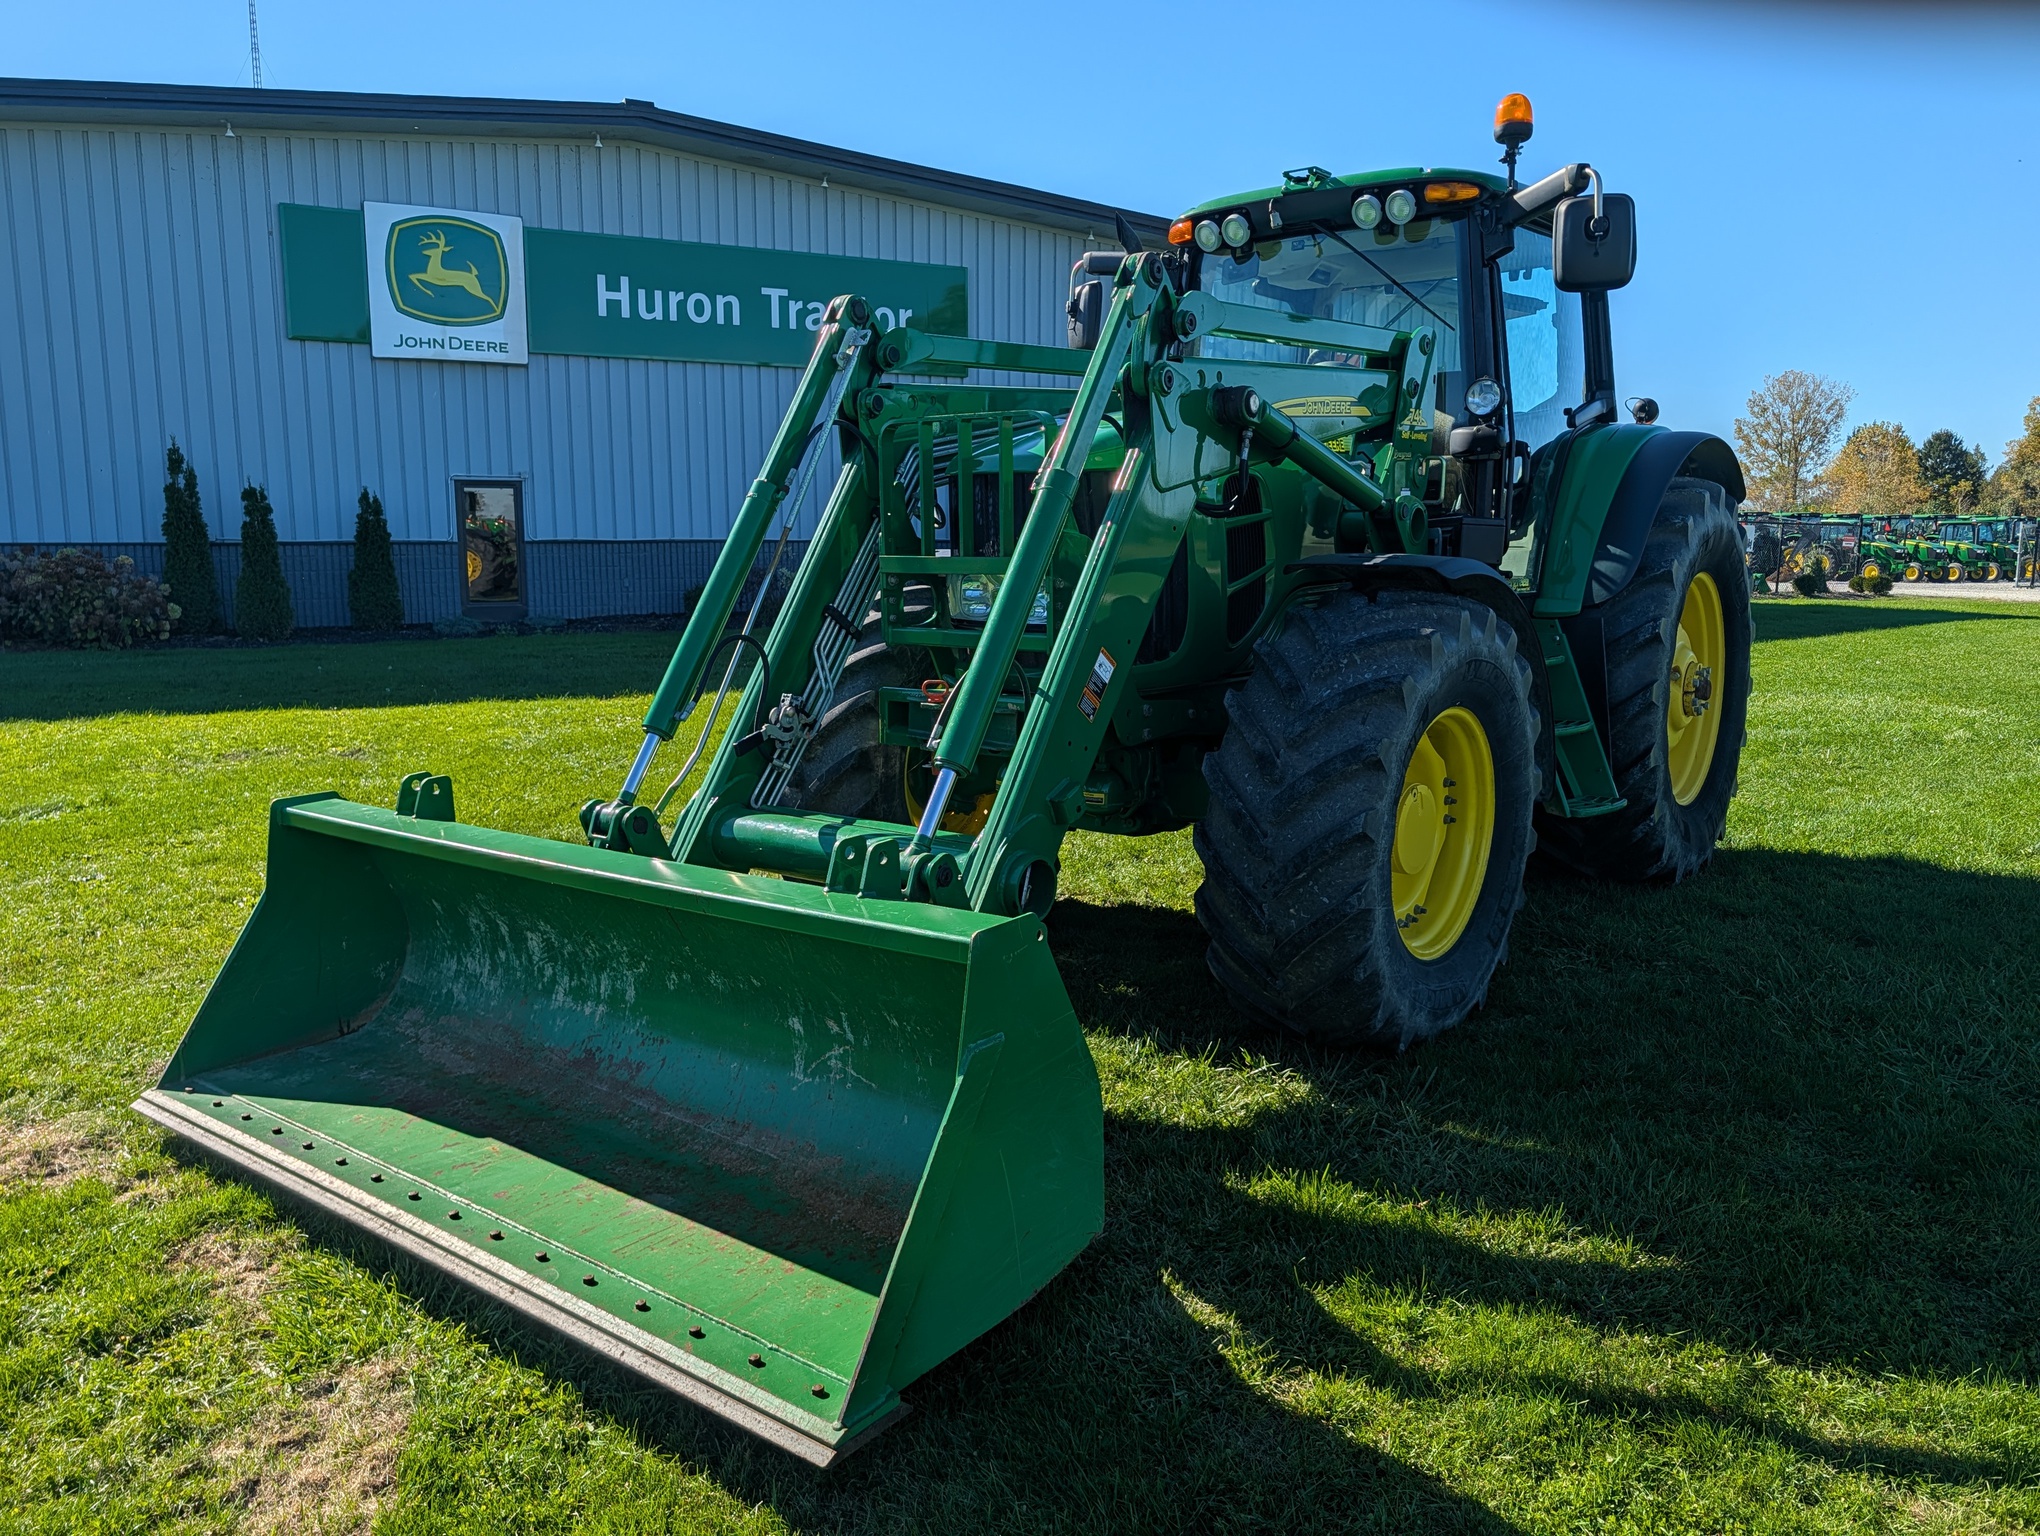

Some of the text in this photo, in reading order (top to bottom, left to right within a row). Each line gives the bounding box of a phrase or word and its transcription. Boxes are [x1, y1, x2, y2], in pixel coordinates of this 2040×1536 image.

[596, 273, 913, 332] Huron Traor
[393, 333, 509, 354] JOHN DEERE
[1302, 399, 1352, 415] JOHN DEERE
[1409, 408, 1423, 424] 741
